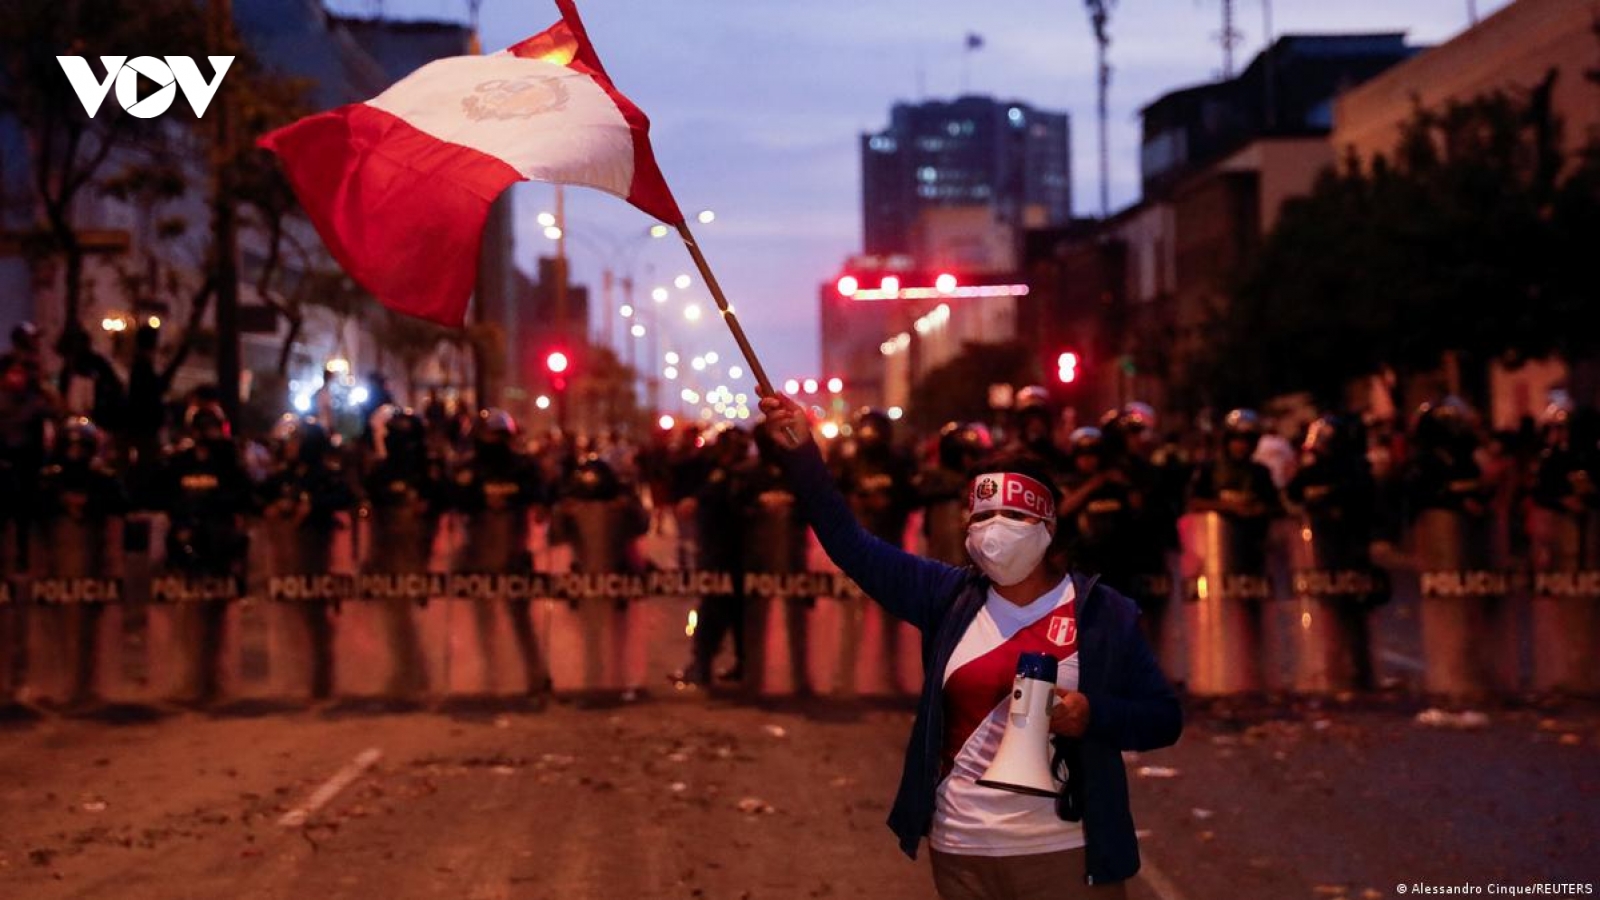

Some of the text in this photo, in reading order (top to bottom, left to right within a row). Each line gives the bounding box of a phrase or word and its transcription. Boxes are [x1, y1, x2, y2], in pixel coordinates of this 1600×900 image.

[1007, 480, 1053, 518] Peru
[32, 579, 118, 602] POLICIA
[151, 576, 238, 600] POLICIA
[361, 573, 443, 597] POLICIA
[453, 574, 546, 599] POLICIA
[554, 573, 643, 598] POLICIA
[650, 570, 734, 596] POLICIA
[743, 572, 832, 597] POLICIA
[1421, 572, 1507, 595] POLICIA
